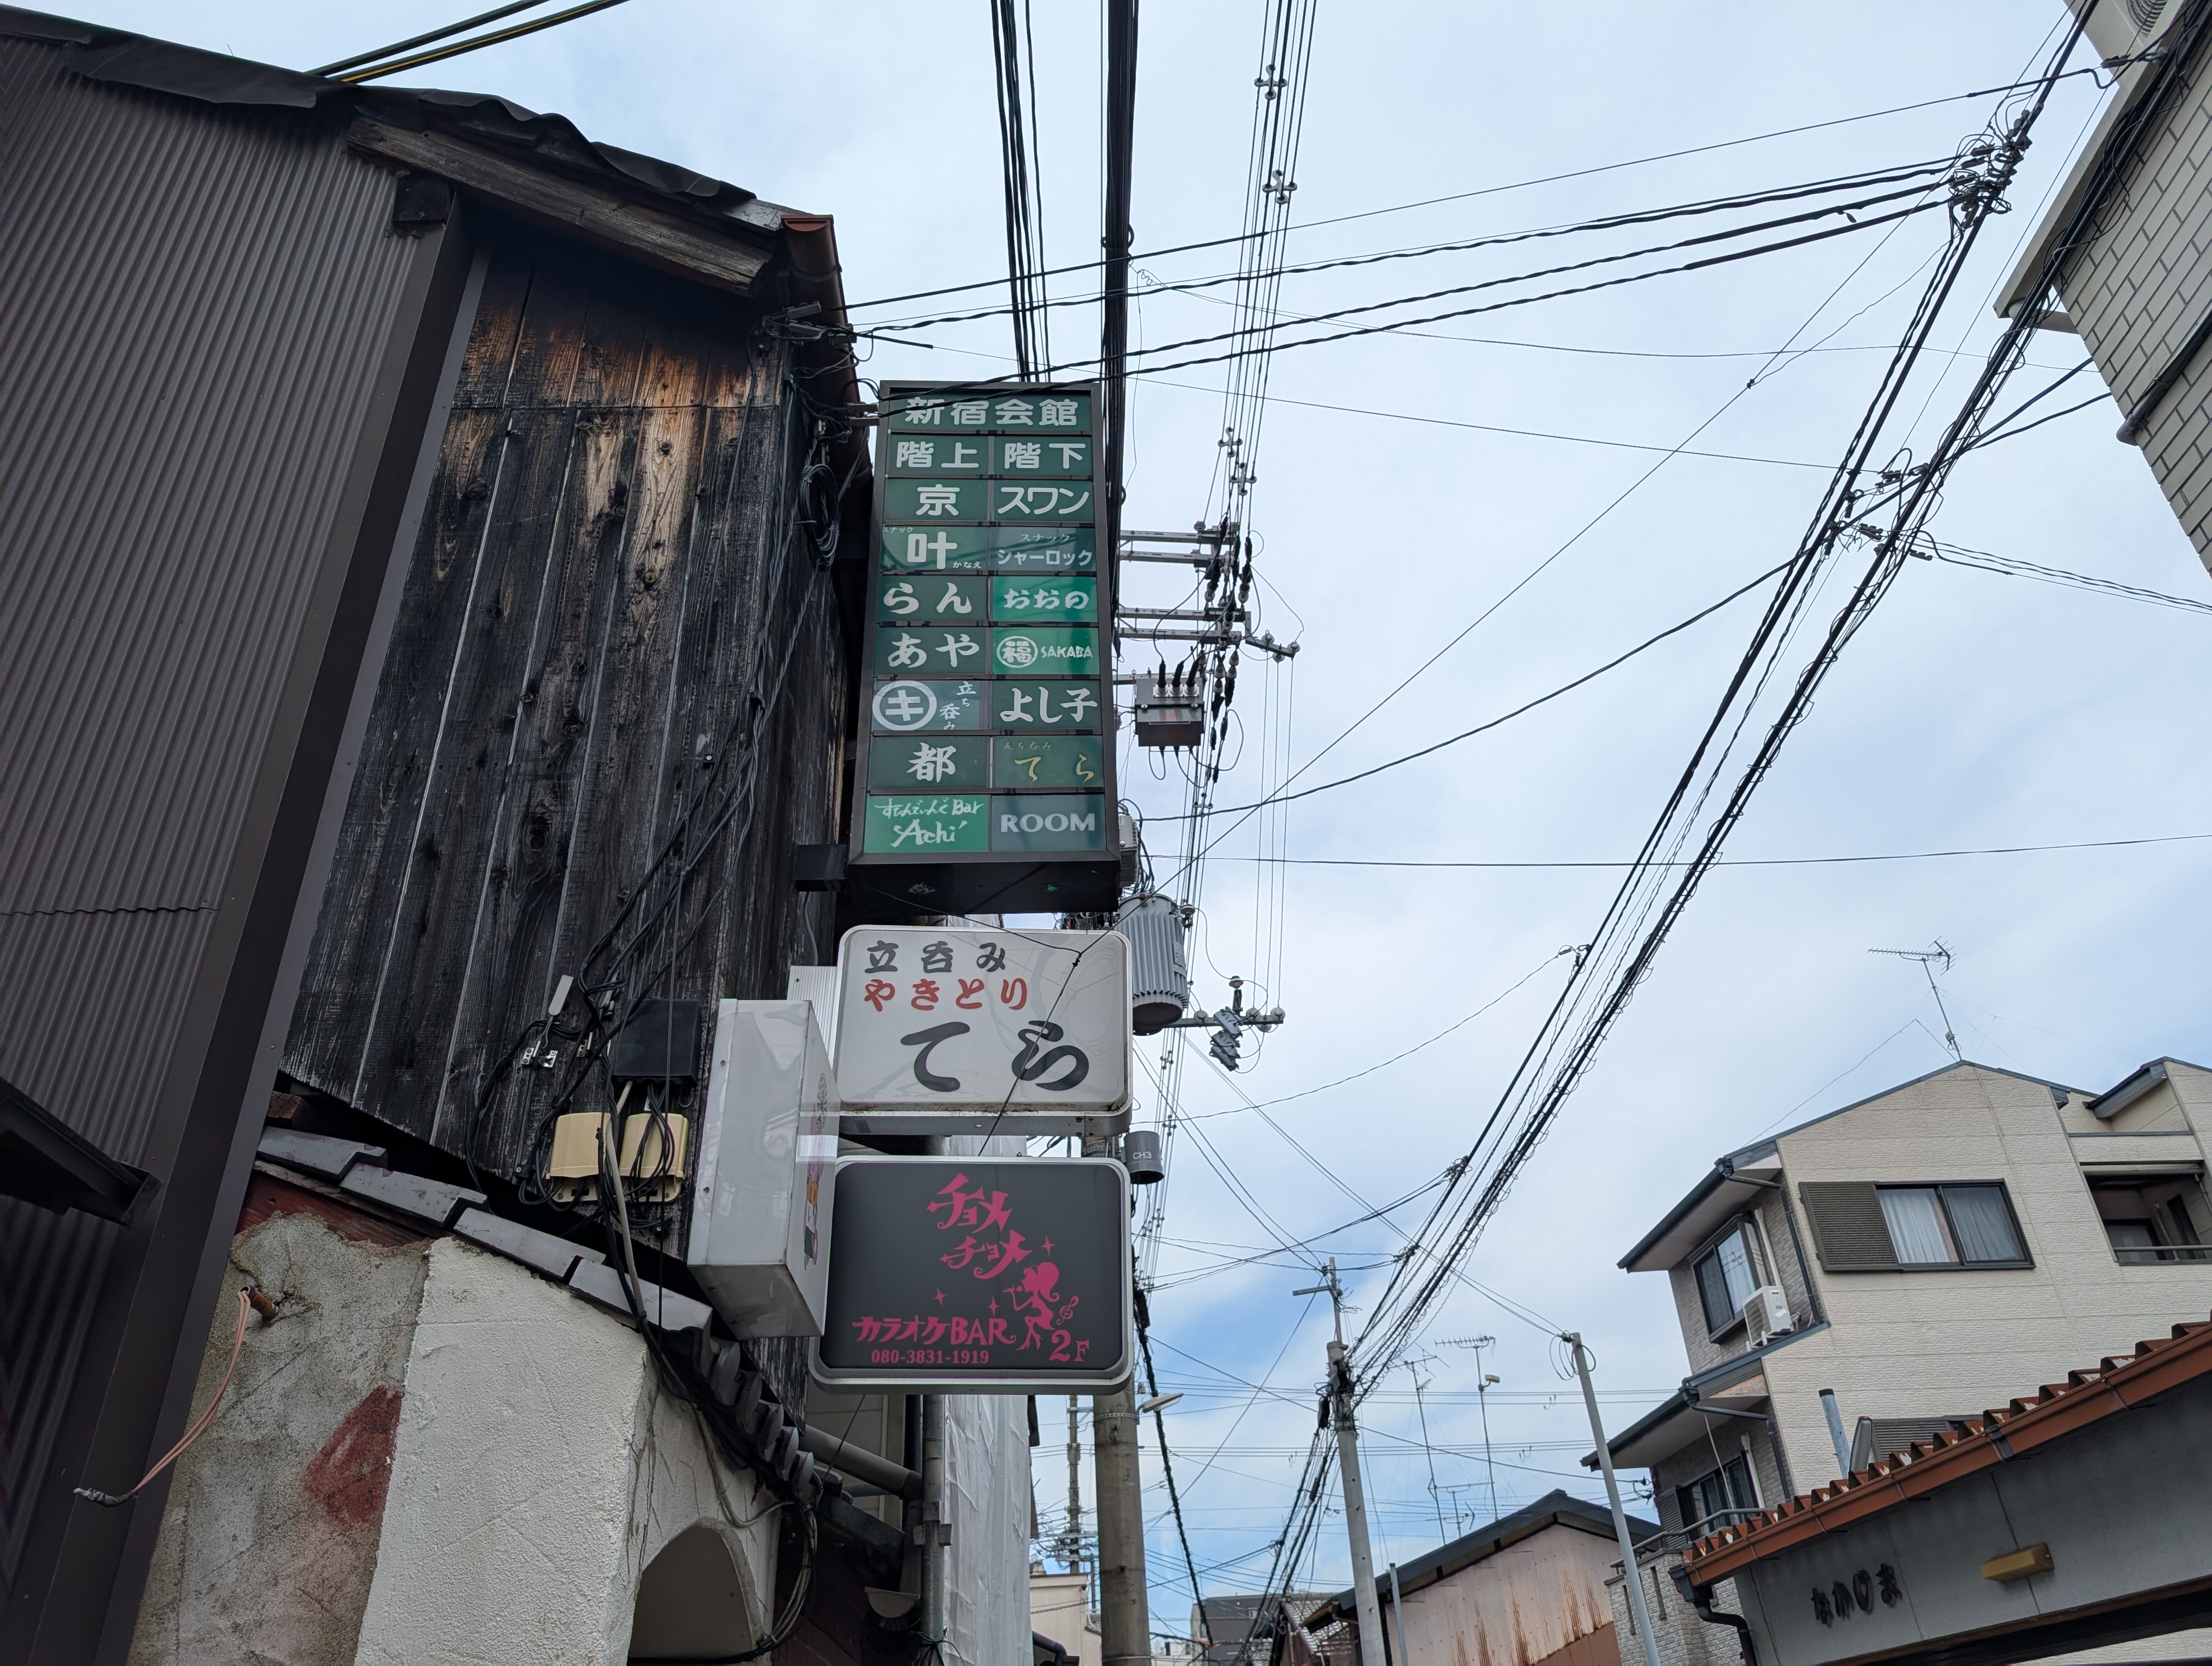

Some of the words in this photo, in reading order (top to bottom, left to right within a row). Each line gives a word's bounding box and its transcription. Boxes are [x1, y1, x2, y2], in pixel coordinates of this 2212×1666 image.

[905, 397, 1078, 426] 新宿会館
[896, 441, 979, 467] 階上
[1005, 443, 1086, 469] 階下
[916, 484, 960, 516] 京
[998, 487, 1089, 515] スワン
[907, 531, 958, 569] 叶
[1020, 533, 1070, 543] スナック
[998, 549, 1092, 566] シャーロック
[883, 582, 972, 614] らん
[1004, 588, 1089, 610] おおの
[888, 632, 980, 668] あや
[1040, 645, 1093, 658] SAKABA
[1000, 687, 1098, 723] よし子
[1003, 741, 1052, 750] 立ち呑み
[906, 742, 956, 783] 都
[1014, 753, 1094, 784] てら
[1001, 813, 1095, 832] ROOM
[864, 940, 1006, 973] 立呑み
[864, 978, 1027, 1012] やきとり
[900, 1020, 1089, 1092] てら
[1133, 1151, 1152, 1159] CH3
[926, 1172, 1012, 1234] チョメ
[871, 1349, 989, 1364] 080-3831-1919
[1049, 1329, 1090, 1362] 2F
